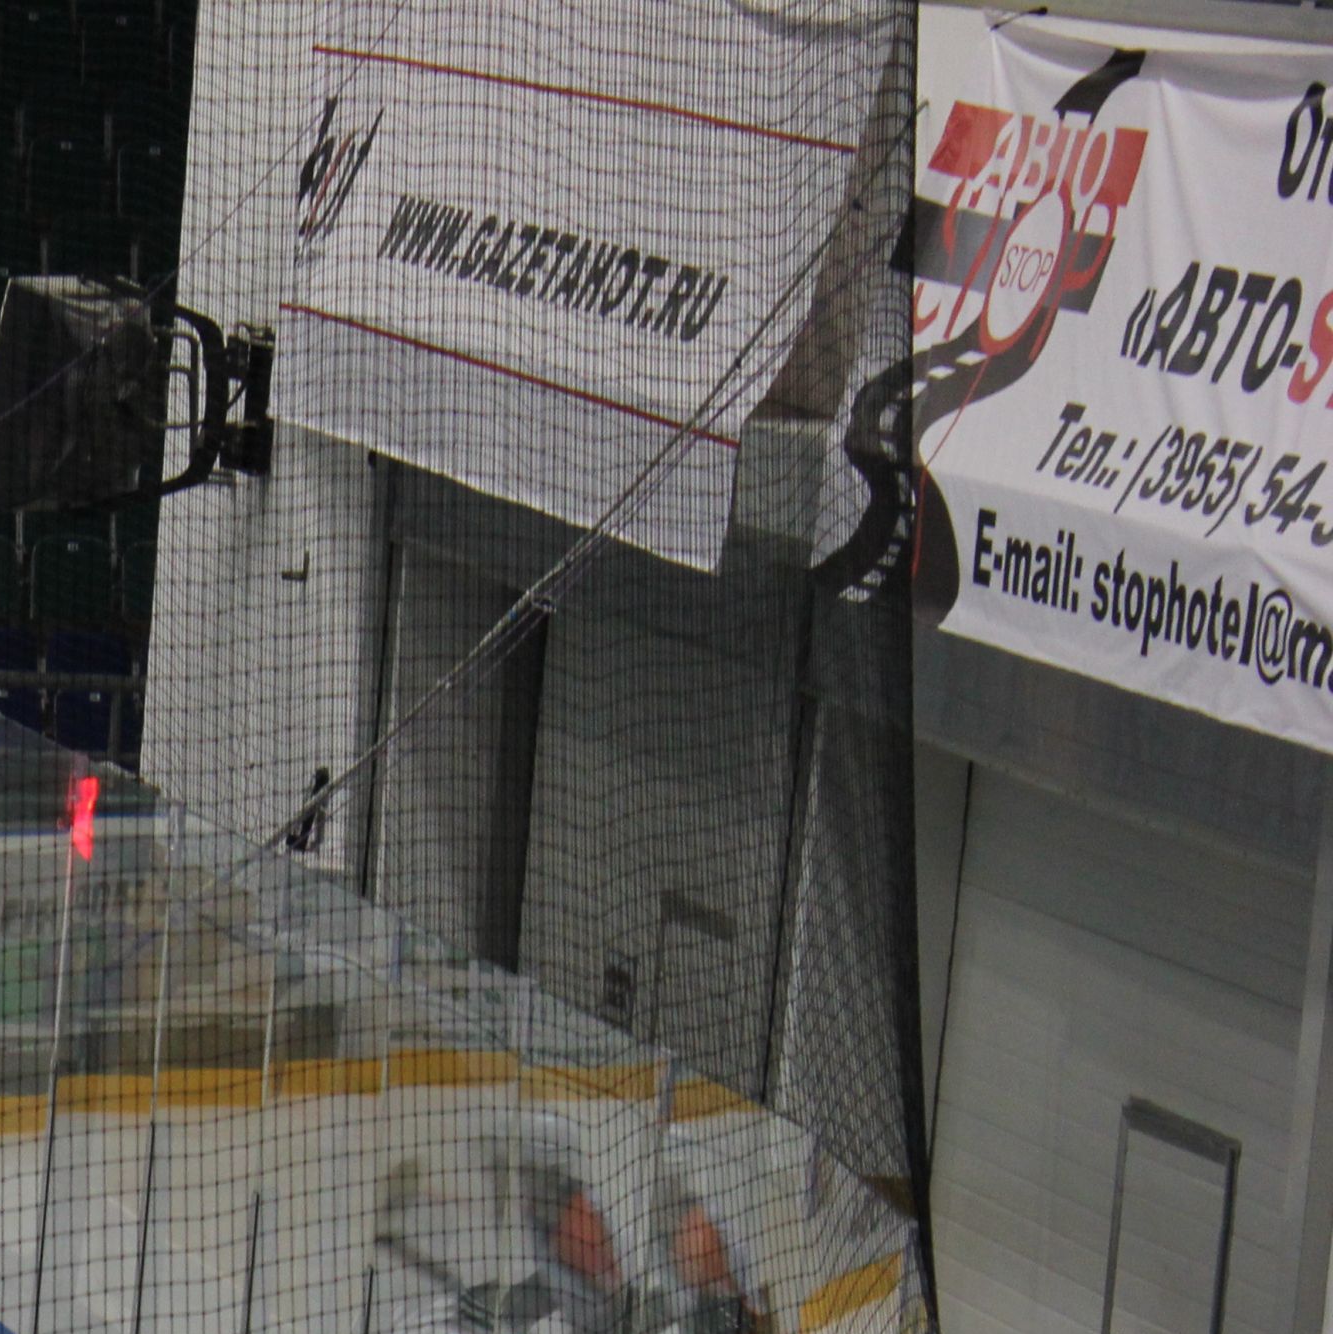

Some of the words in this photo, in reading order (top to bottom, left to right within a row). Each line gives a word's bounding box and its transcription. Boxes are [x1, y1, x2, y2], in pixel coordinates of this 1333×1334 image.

[999, 245, 1055, 293] STOP
[1036, 402, 1157, 489] Тел.:
[1114, 425, 1283, 539] (3955)
[973, 508, 1083, 613] E-mail:
[1091, 548, 1333, 692] stophotel@m
